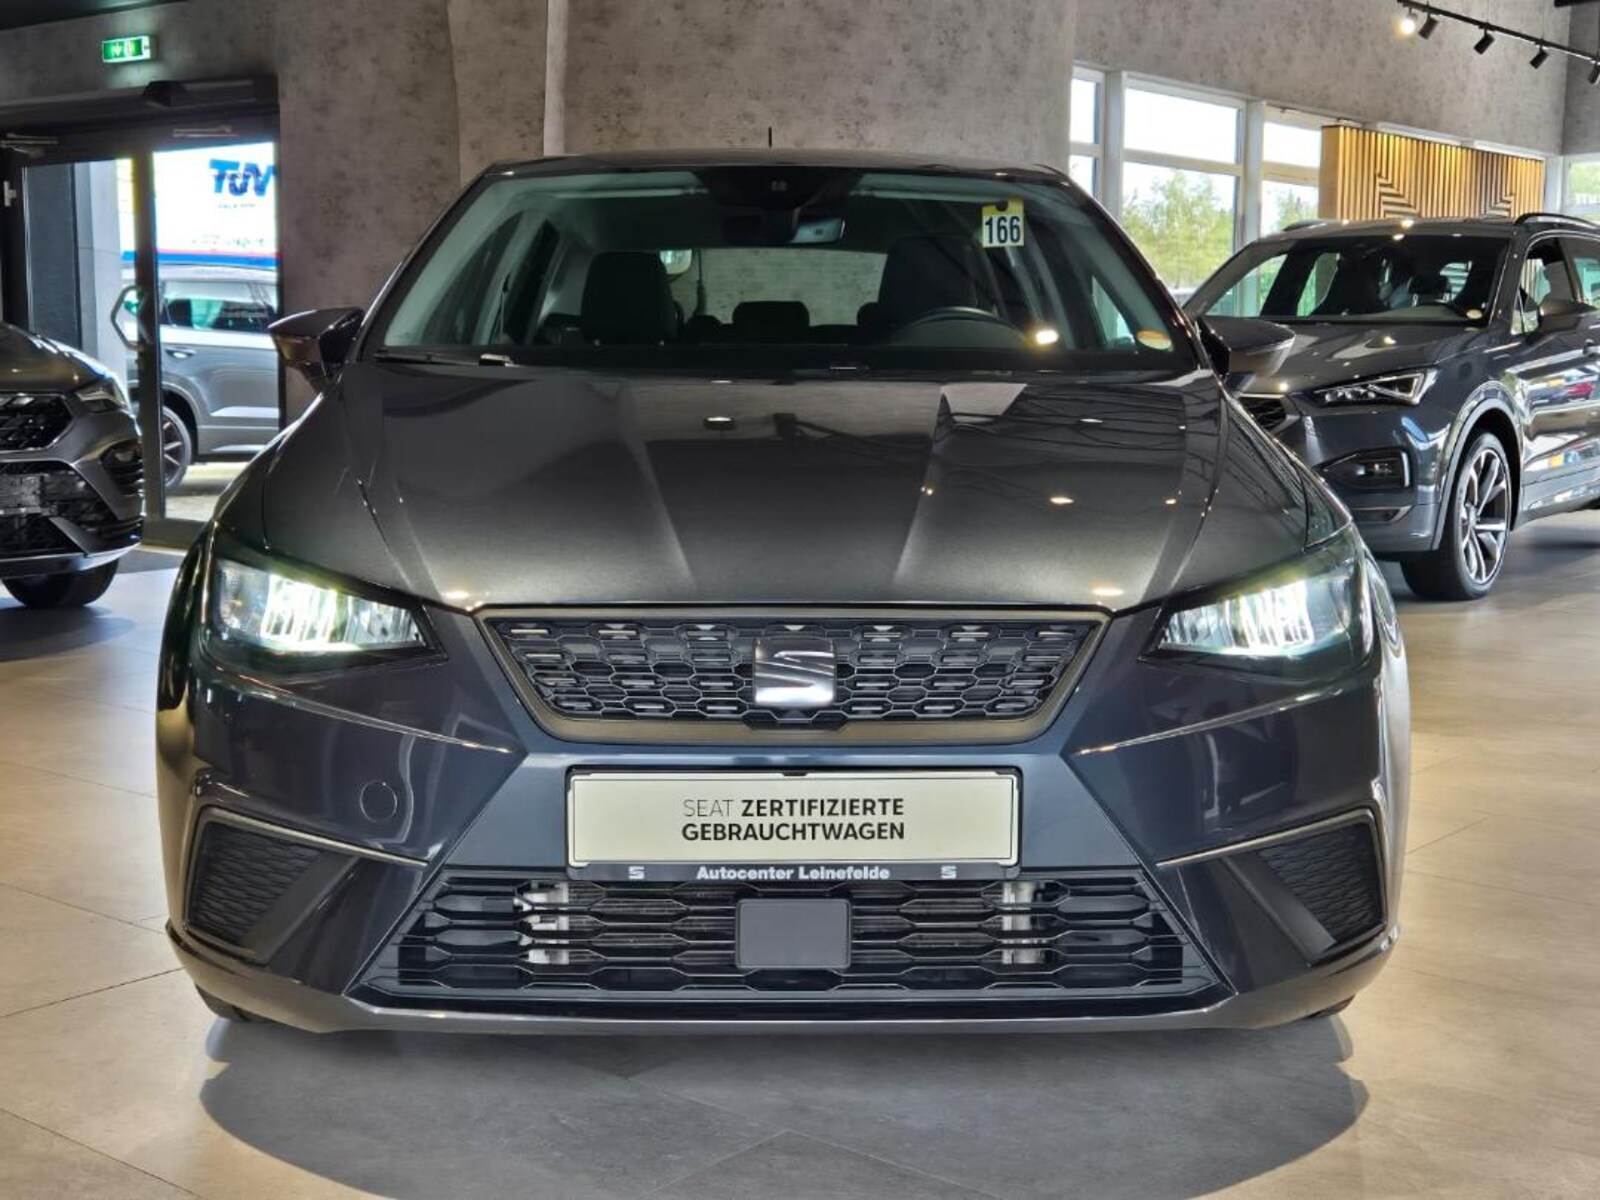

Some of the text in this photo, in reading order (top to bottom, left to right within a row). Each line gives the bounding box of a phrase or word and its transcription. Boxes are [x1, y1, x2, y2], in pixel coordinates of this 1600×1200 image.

[985, 216, 1021, 243] 166
[684, 798, 904, 817] SEAT ZERTIFIZIERTE
[682, 822, 905, 841] GEBRAUCHTWAGEN
[697, 866, 794, 880] Autocenter
[799, 866, 890, 880] Leinefelde
